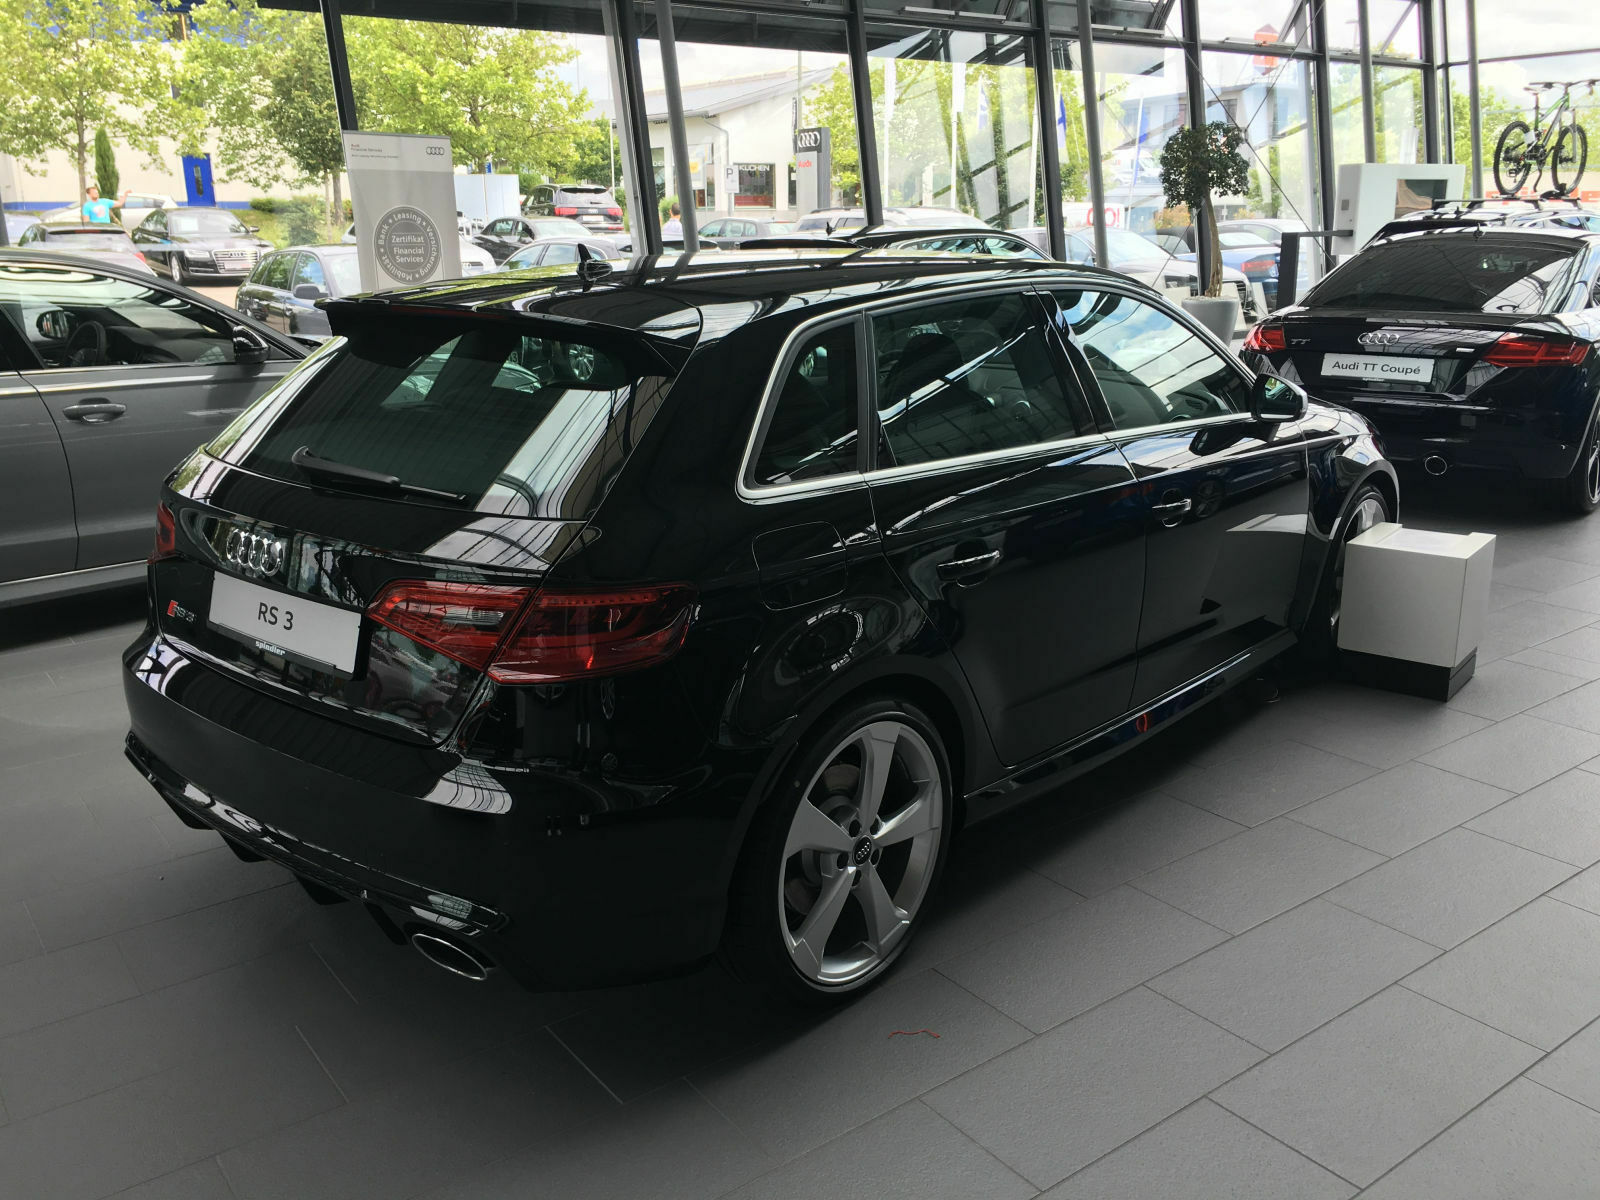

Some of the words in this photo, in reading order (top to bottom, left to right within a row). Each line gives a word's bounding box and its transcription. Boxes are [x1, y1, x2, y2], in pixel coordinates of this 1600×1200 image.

[726, 167, 734, 179] P
[393, 212, 422, 224] Leasing
[378, 223, 390, 245] Bank
[391, 235, 425, 243] Zertifikat
[393, 247, 425, 255] Financial
[420, 226, 438, 277] Versicherung
[395, 255, 424, 263] Services
[1332, 361, 1360, 371] Audi
[1363, 363, 1378, 372] TT
[1381, 364, 1421, 375] Coupé
[257, 601, 278, 626] RS
[283, 610, 294, 631] 3
[255, 640, 286, 656] spindler
